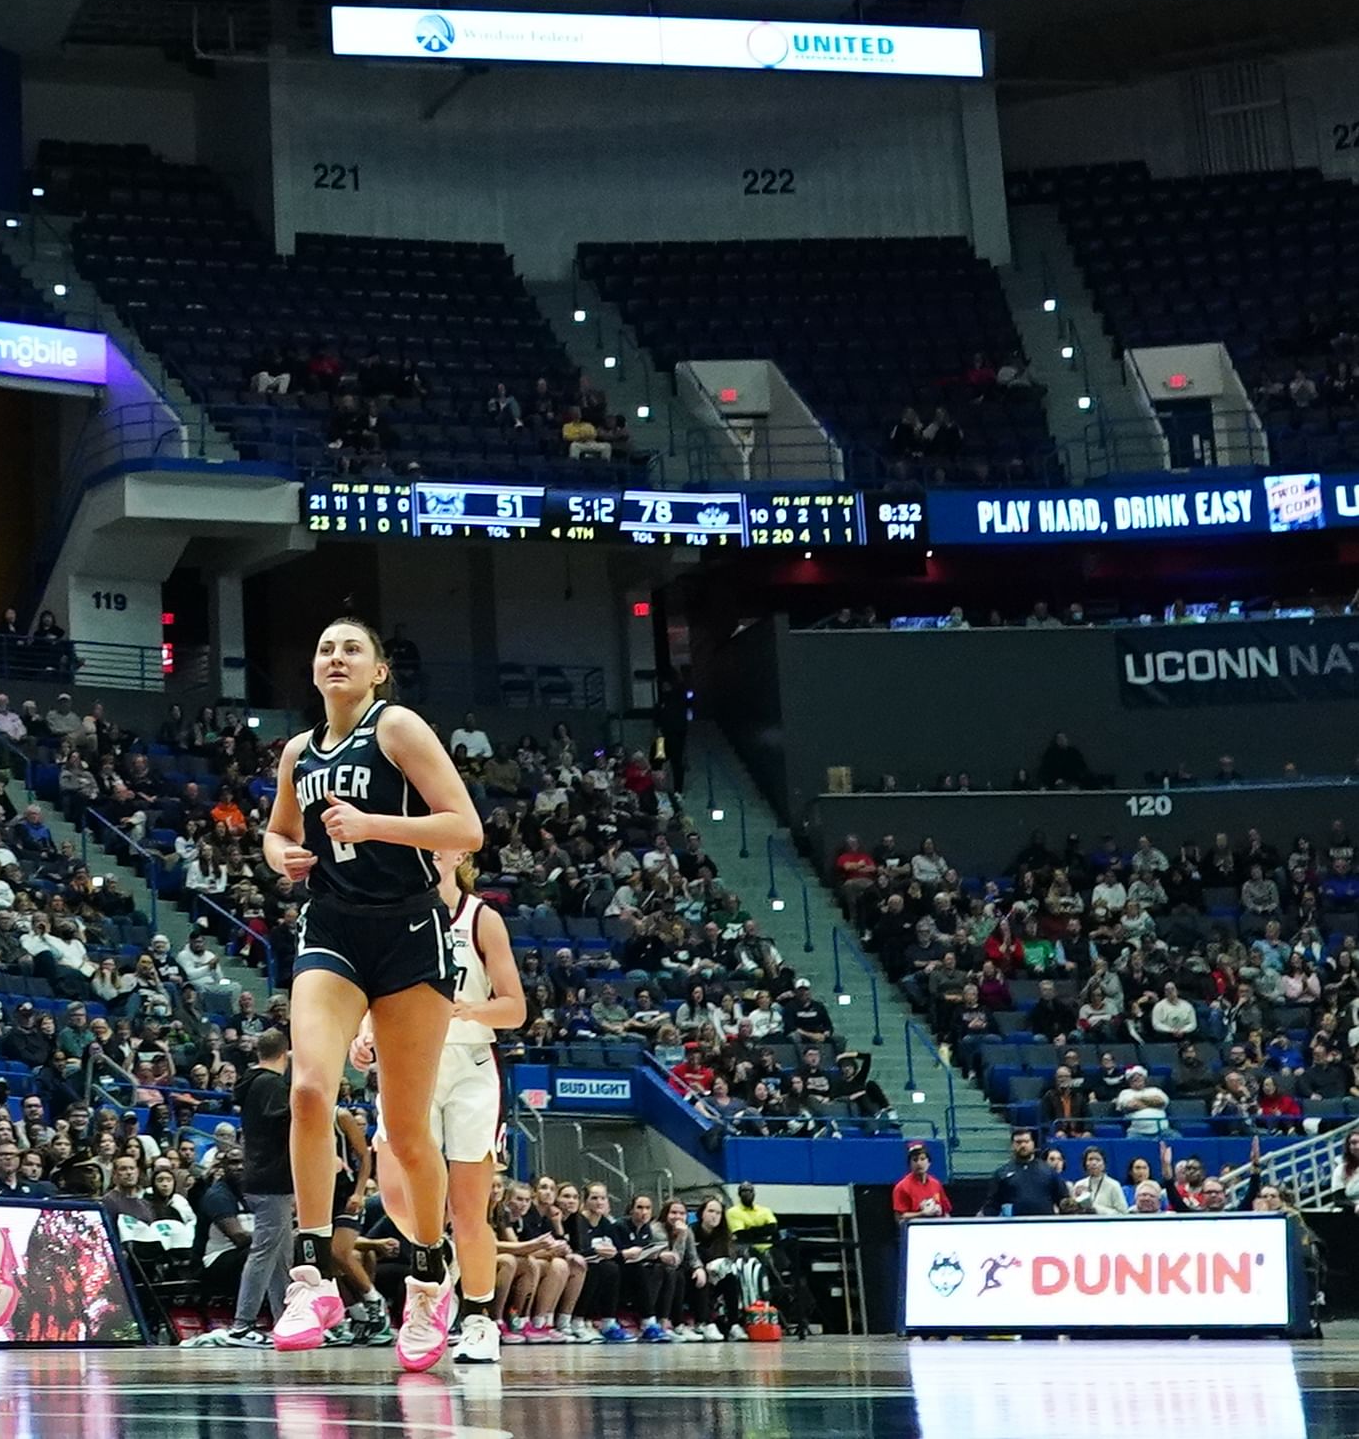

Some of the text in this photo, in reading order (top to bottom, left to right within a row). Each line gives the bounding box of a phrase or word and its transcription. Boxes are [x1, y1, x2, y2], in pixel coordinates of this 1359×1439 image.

[794, 34, 894, 55] UNITED
[313, 163, 359, 191] 221
[742, 169, 795, 195] 222
[310, 494, 327, 510] 21
[334, 496, 347, 510] 11
[358, 496, 365, 510] 1
[397, 498, 410, 512] 0
[496, 494, 523, 518] 51
[568, 496, 615, 522] 5:12
[639, 500, 672, 523] 78
[879, 503, 922, 522] 8:32
[977, 489, 1252, 534] PLAY HARD, DRINK EASY
[310, 515, 408, 533] 23 3 1 0 1
[750, 509, 769, 524] 10
[798, 508, 809, 523] 2
[821, 508, 829, 523] 1
[843, 507, 851, 522] 1
[487, 527, 511, 538] TOL
[751, 528, 852, 544] 12 20 4 1 1
[887, 524, 915, 540] PM
[92, 591, 127, 611] 119
[1125, 646, 1279, 685] UCONN
[296, 765, 370, 813] BUTLER
[1126, 795, 1172, 816] 120
[560, 1082, 627, 1095] BUD LIGHT
[1032, 1253, 1264, 1295] DUNKIN'
